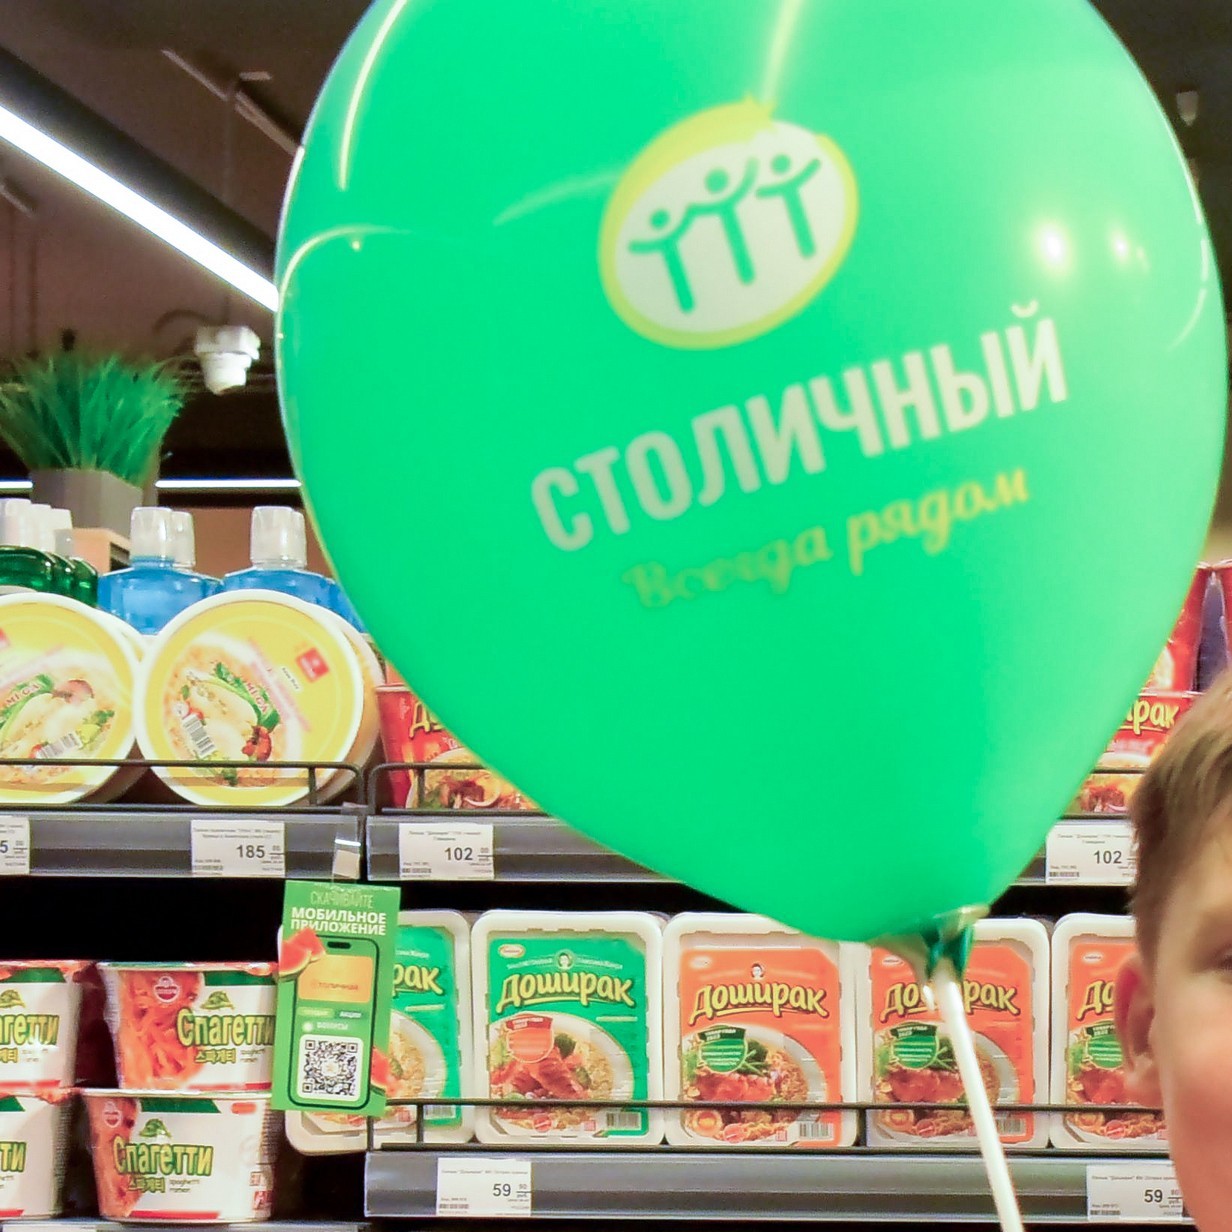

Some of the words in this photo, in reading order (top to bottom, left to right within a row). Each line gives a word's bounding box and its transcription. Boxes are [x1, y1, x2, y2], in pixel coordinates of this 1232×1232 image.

[531, 300, 1068, 552] СТОЛИЧНЫЙ
[847, 467, 1029, 575] рядом
[236, 844, 265, 859] 185
[445, 847, 473, 861] 102
[1093, 850, 1122, 864] 102
[291, 907, 387, 925] МОБИЛЬНОЕ
[290, 919, 387, 936] ПРИЛОЖЕНИЕ
[495, 971, 635, 1015] Доширак
[689, 979, 830, 1026] Доширак
[177, 1006, 276, 1048] Спагетти
[113, 1136, 214, 1178] Спагетти
[492, 1183, 512, 1198] 59
[1144, 1189, 1163, 1203] 59
